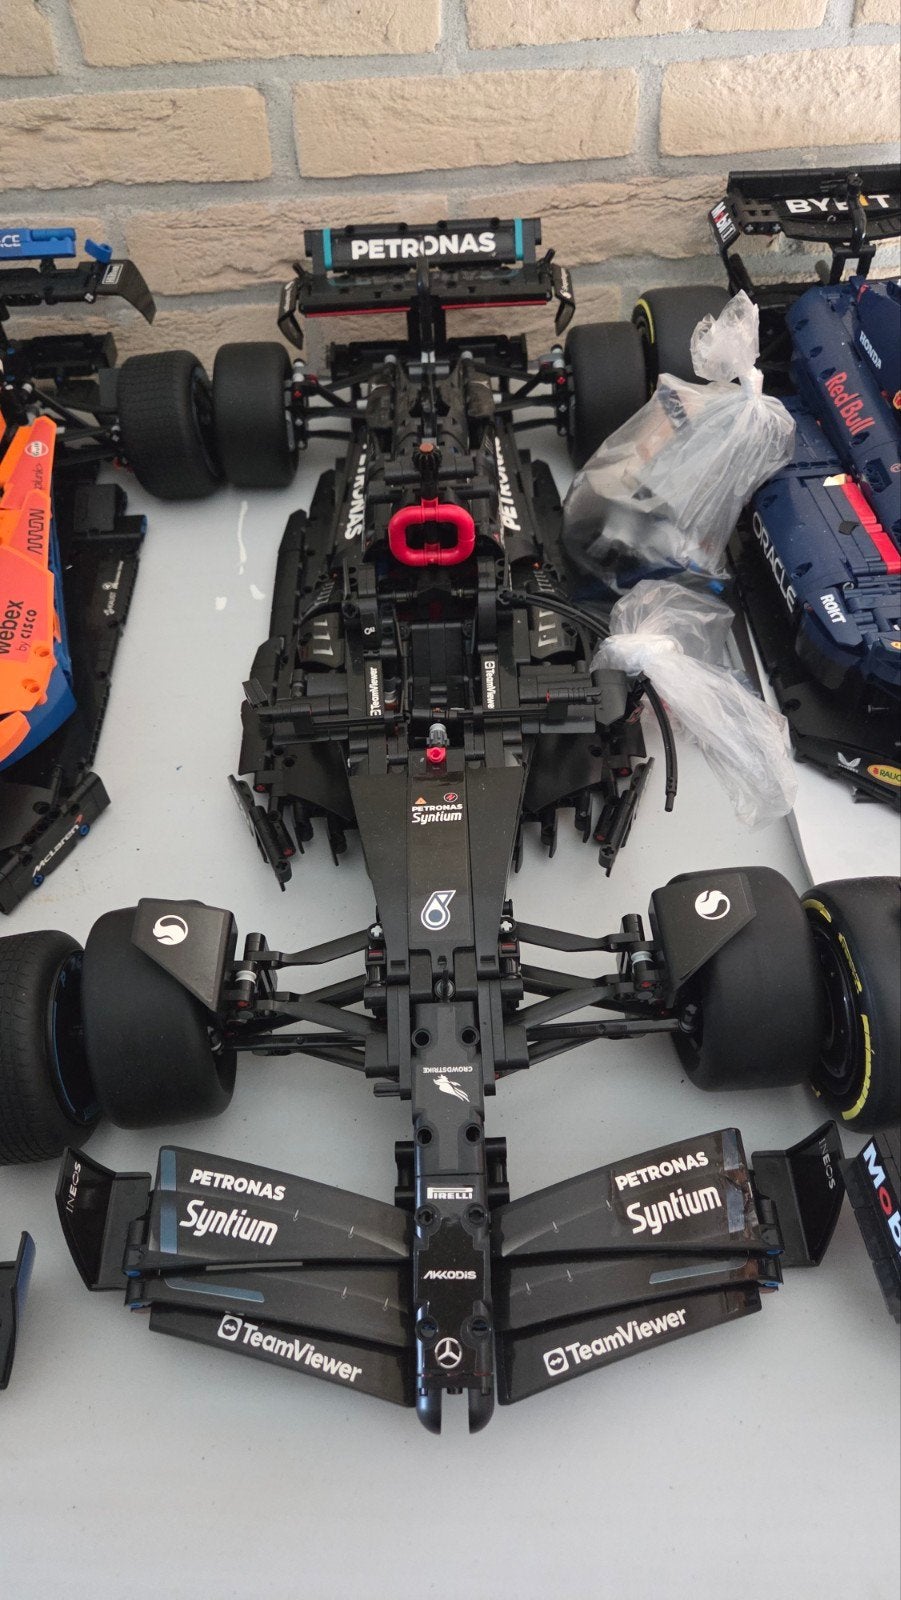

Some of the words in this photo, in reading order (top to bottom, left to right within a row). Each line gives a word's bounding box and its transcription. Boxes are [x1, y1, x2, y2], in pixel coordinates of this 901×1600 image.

[0, 234, 21, 248] CE
[351, 231, 496, 260] PETRONAS
[859, 330, 882, 370] HONDA
[825, 371, 860, 407] Red
[840, 399, 875, 435] Bull
[753, 511, 797, 613] ORACLE
[820, 594, 846, 623] ROKT
[369, 667, 381, 710] TeamViewer
[485, 668, 497, 709] TeamViewe
[412, 804, 463, 812] PETRONAS
[412, 811, 463, 825] Syntium
[615, 1151, 709, 1191] PETRONAS
[819, 1137, 836, 1190] INEOS
[66, 1161, 82, 1213] INEOS
[190, 1168, 287, 1201] PETRONAS
[427, 1187, 473, 1199] PIRELLI
[179, 1200, 279, 1246] Syntium
[626, 1186, 722, 1235] Syntium
[242, 1322, 362, 1382] TeamViewer
[566, 1308, 686, 1364] TeamViewer
